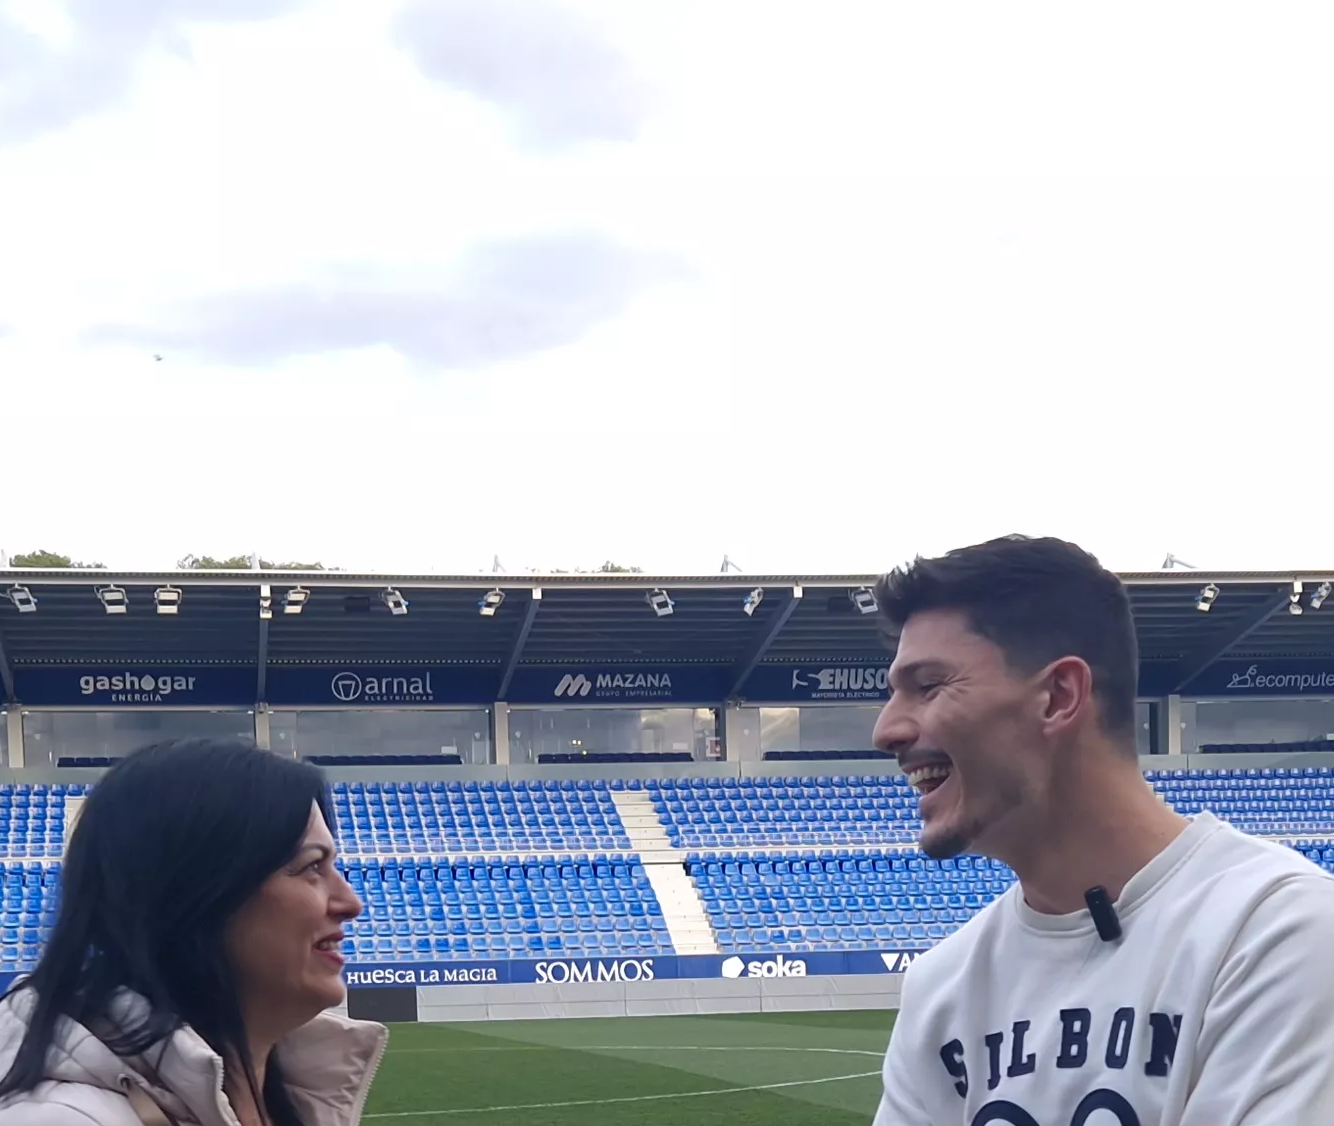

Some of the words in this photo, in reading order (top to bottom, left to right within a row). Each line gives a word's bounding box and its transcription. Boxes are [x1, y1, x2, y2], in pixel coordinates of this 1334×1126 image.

[364, 671, 433, 694] arnal
[596, 673, 672, 688] MAZANA
[535, 959, 654, 984] SOMMOS
[747, 954, 807, 978] soka
[939, 1006, 1183, 1099] SILBON
